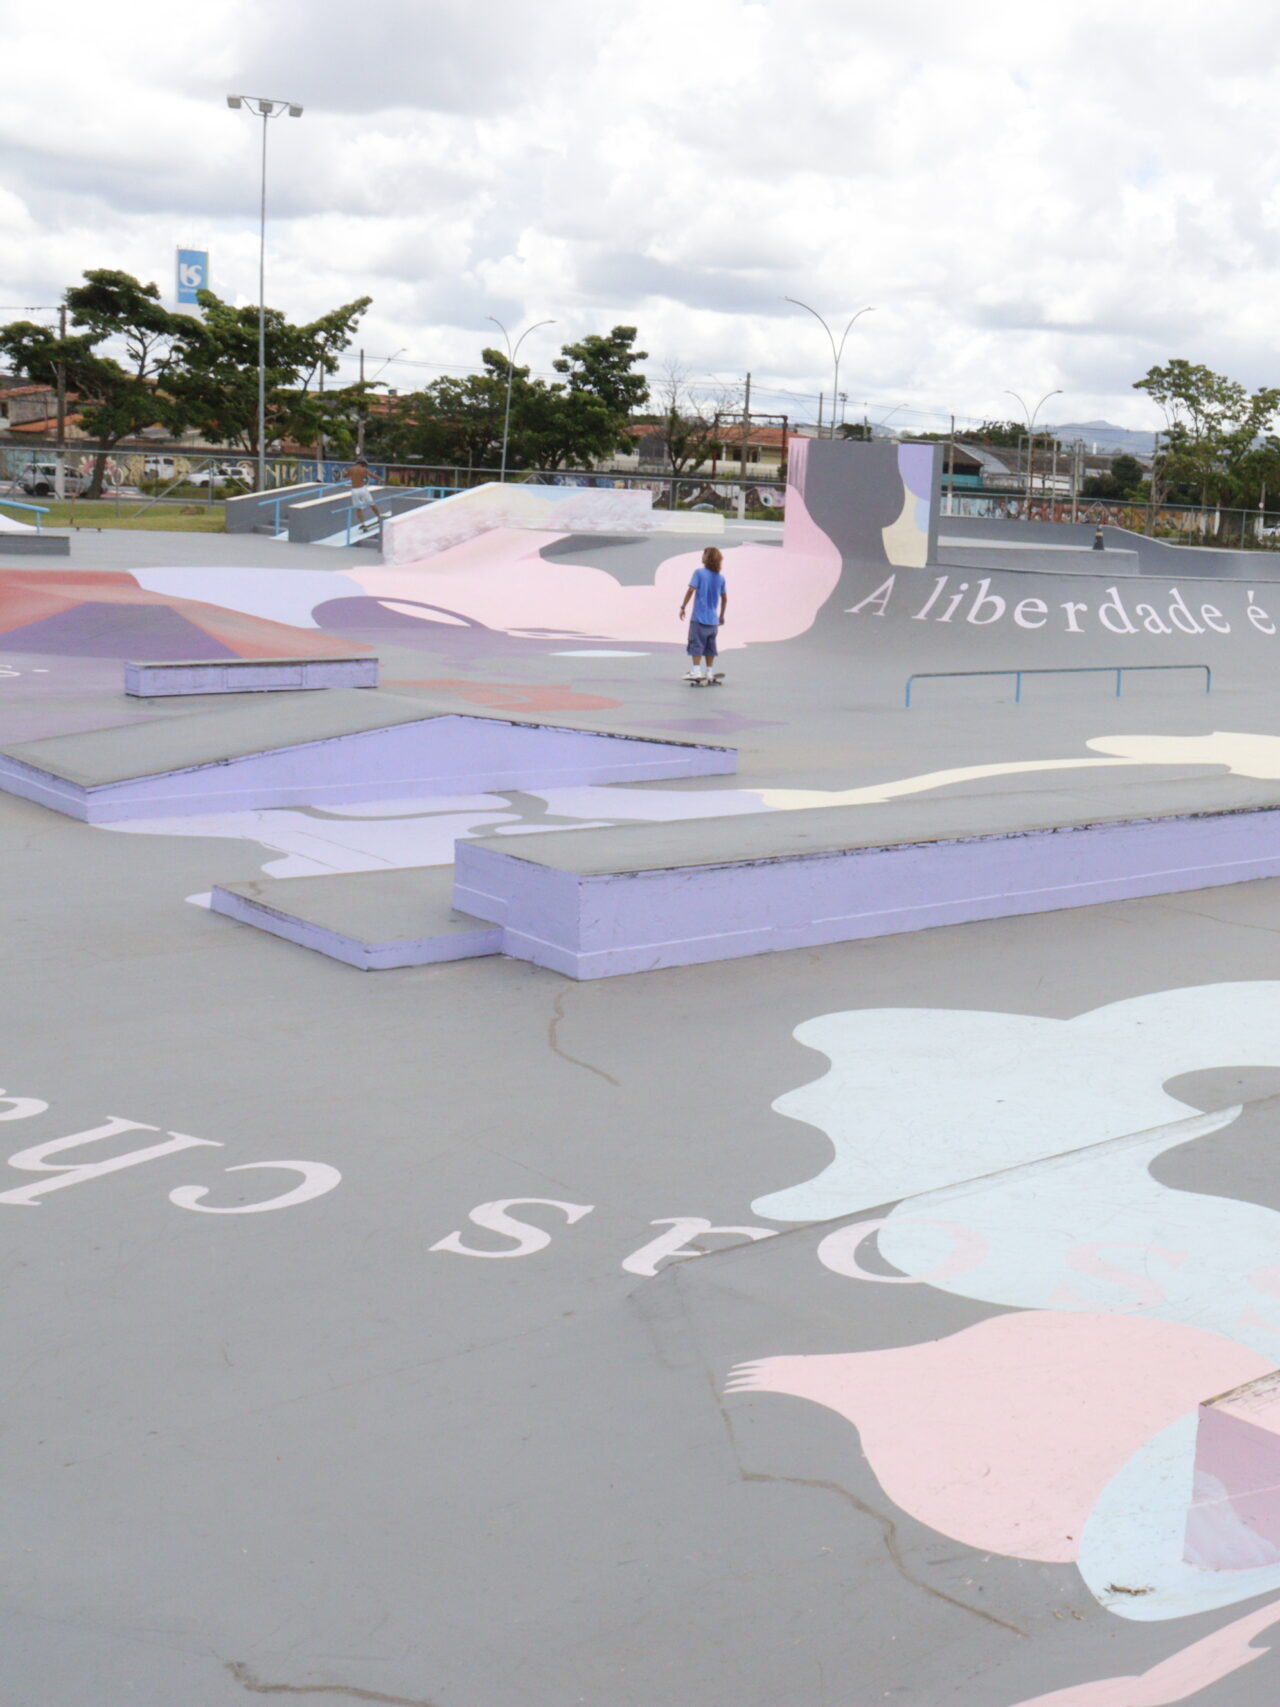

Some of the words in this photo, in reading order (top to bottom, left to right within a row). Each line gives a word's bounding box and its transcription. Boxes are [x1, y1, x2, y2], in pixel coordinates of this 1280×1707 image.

[845, 573, 896, 617] A
[911, 575, 1232, 635] liberdade
[1246, 590, 1277, 635] é
